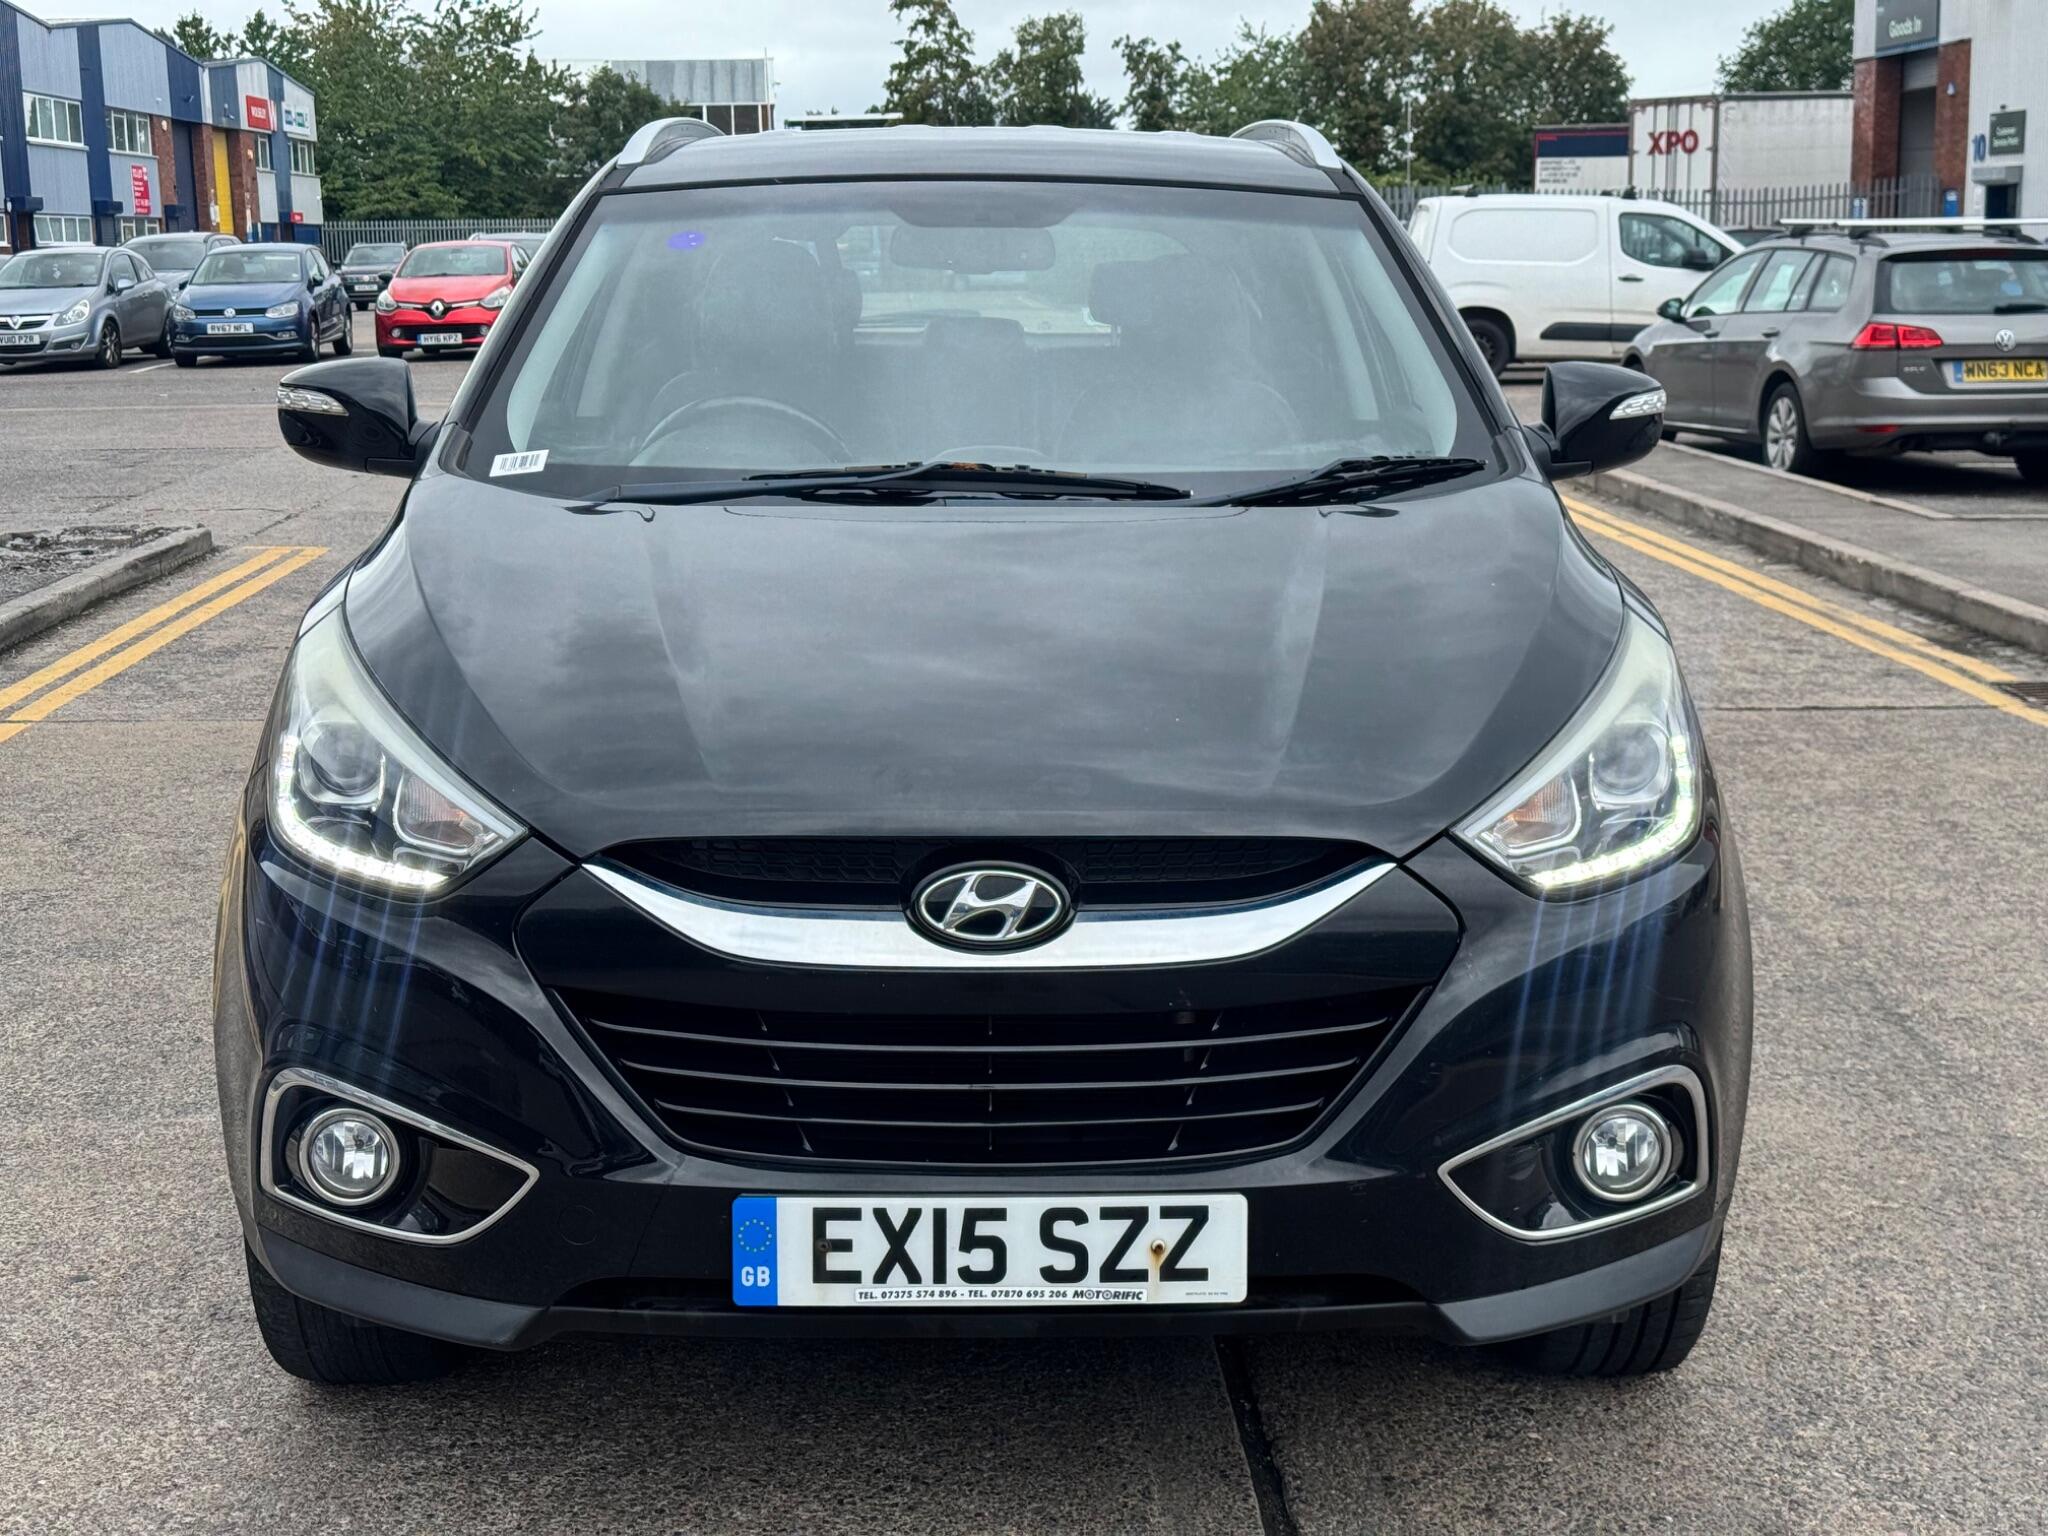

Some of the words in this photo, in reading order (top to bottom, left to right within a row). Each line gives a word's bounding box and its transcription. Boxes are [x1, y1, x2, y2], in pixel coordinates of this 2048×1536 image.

[1647, 129, 1699, 155] XPO
[1972, 134, 1986, 162] 10
[1965, 361, 2009, 378] WN63
[2013, 361, 2044, 378] NCA
[812, 1207, 1007, 1284] EX15
[1039, 1205, 1209, 1283] SZZ
[741, 1266, 770, 1287] GB
[859, 1291, 878, 1300] TEL.
[881, 1290, 913, 1299] 07375
[916, 1290, 936, 1299] 574
[938, 1289, 958, 1298] 896
[968, 1289, 988, 1298] TEL.
[991, 1289, 1023, 1298] 07870
[1026, 1289, 1046, 1298] 695
[1048, 1289, 1068, 1298] 206
[1072, 1289, 1143, 1301] MOTORIFIC
